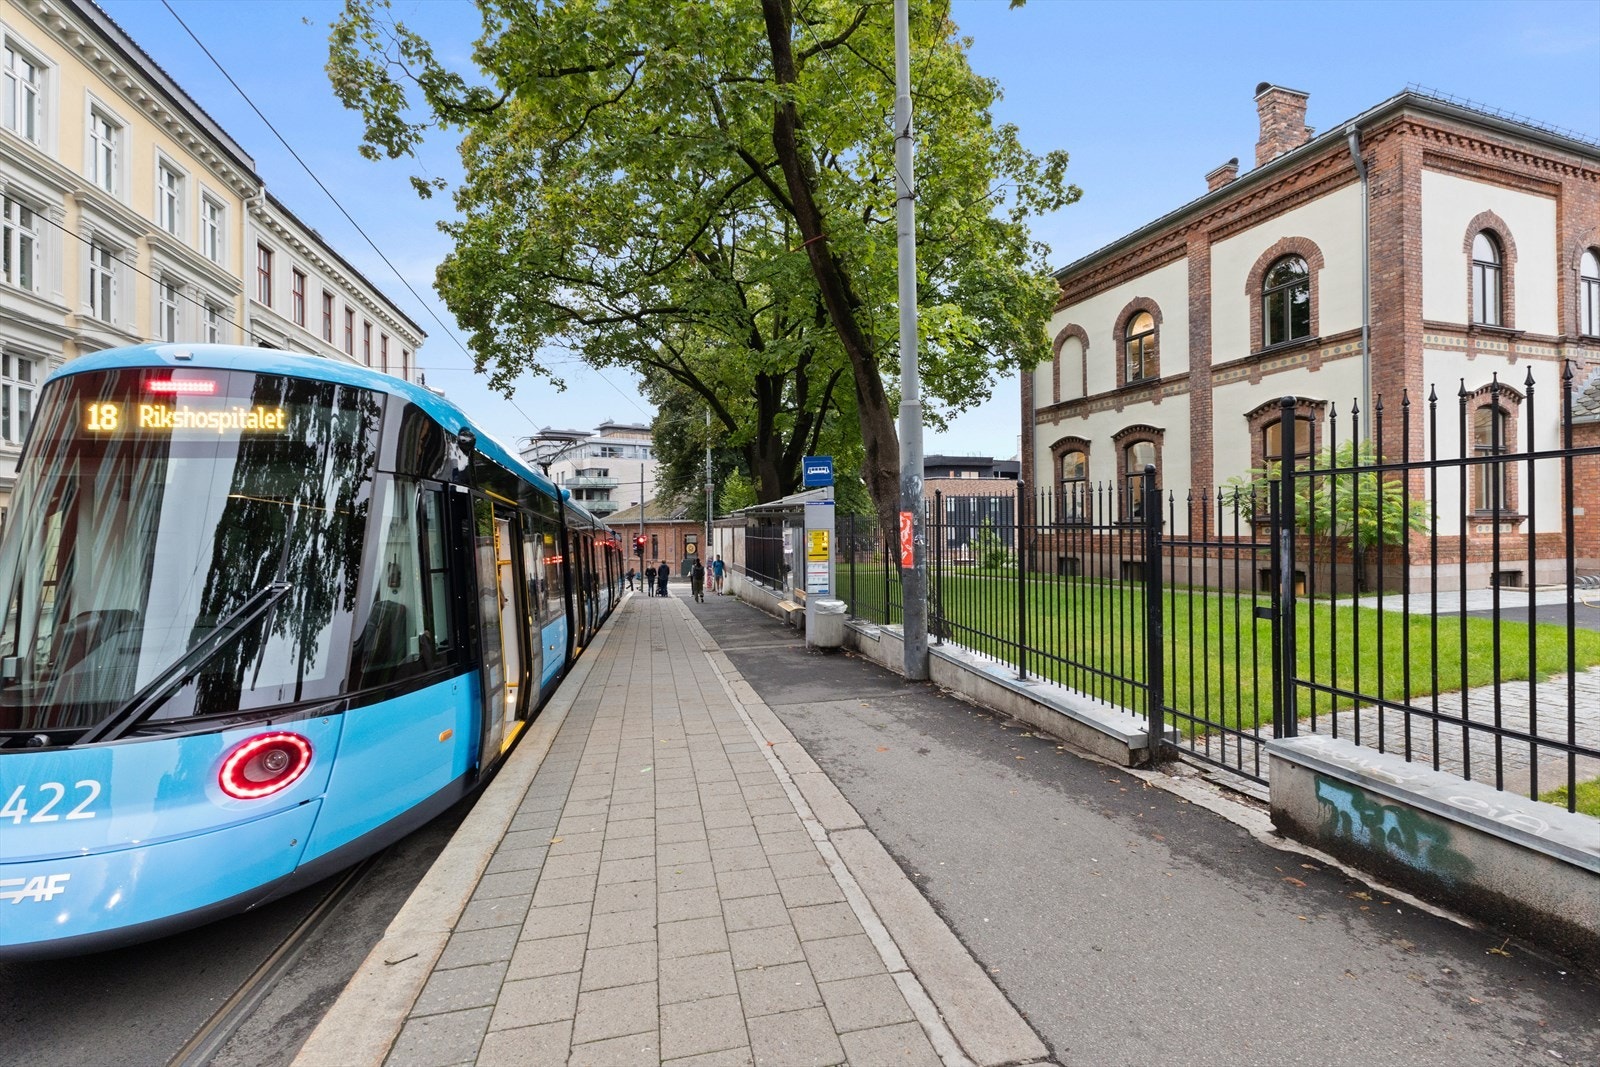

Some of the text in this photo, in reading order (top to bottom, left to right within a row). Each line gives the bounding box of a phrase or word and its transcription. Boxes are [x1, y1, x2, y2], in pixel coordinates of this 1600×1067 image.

[88, 404, 285, 434] 18 Rikshospitalet
[0, 779, 101, 824] 422
